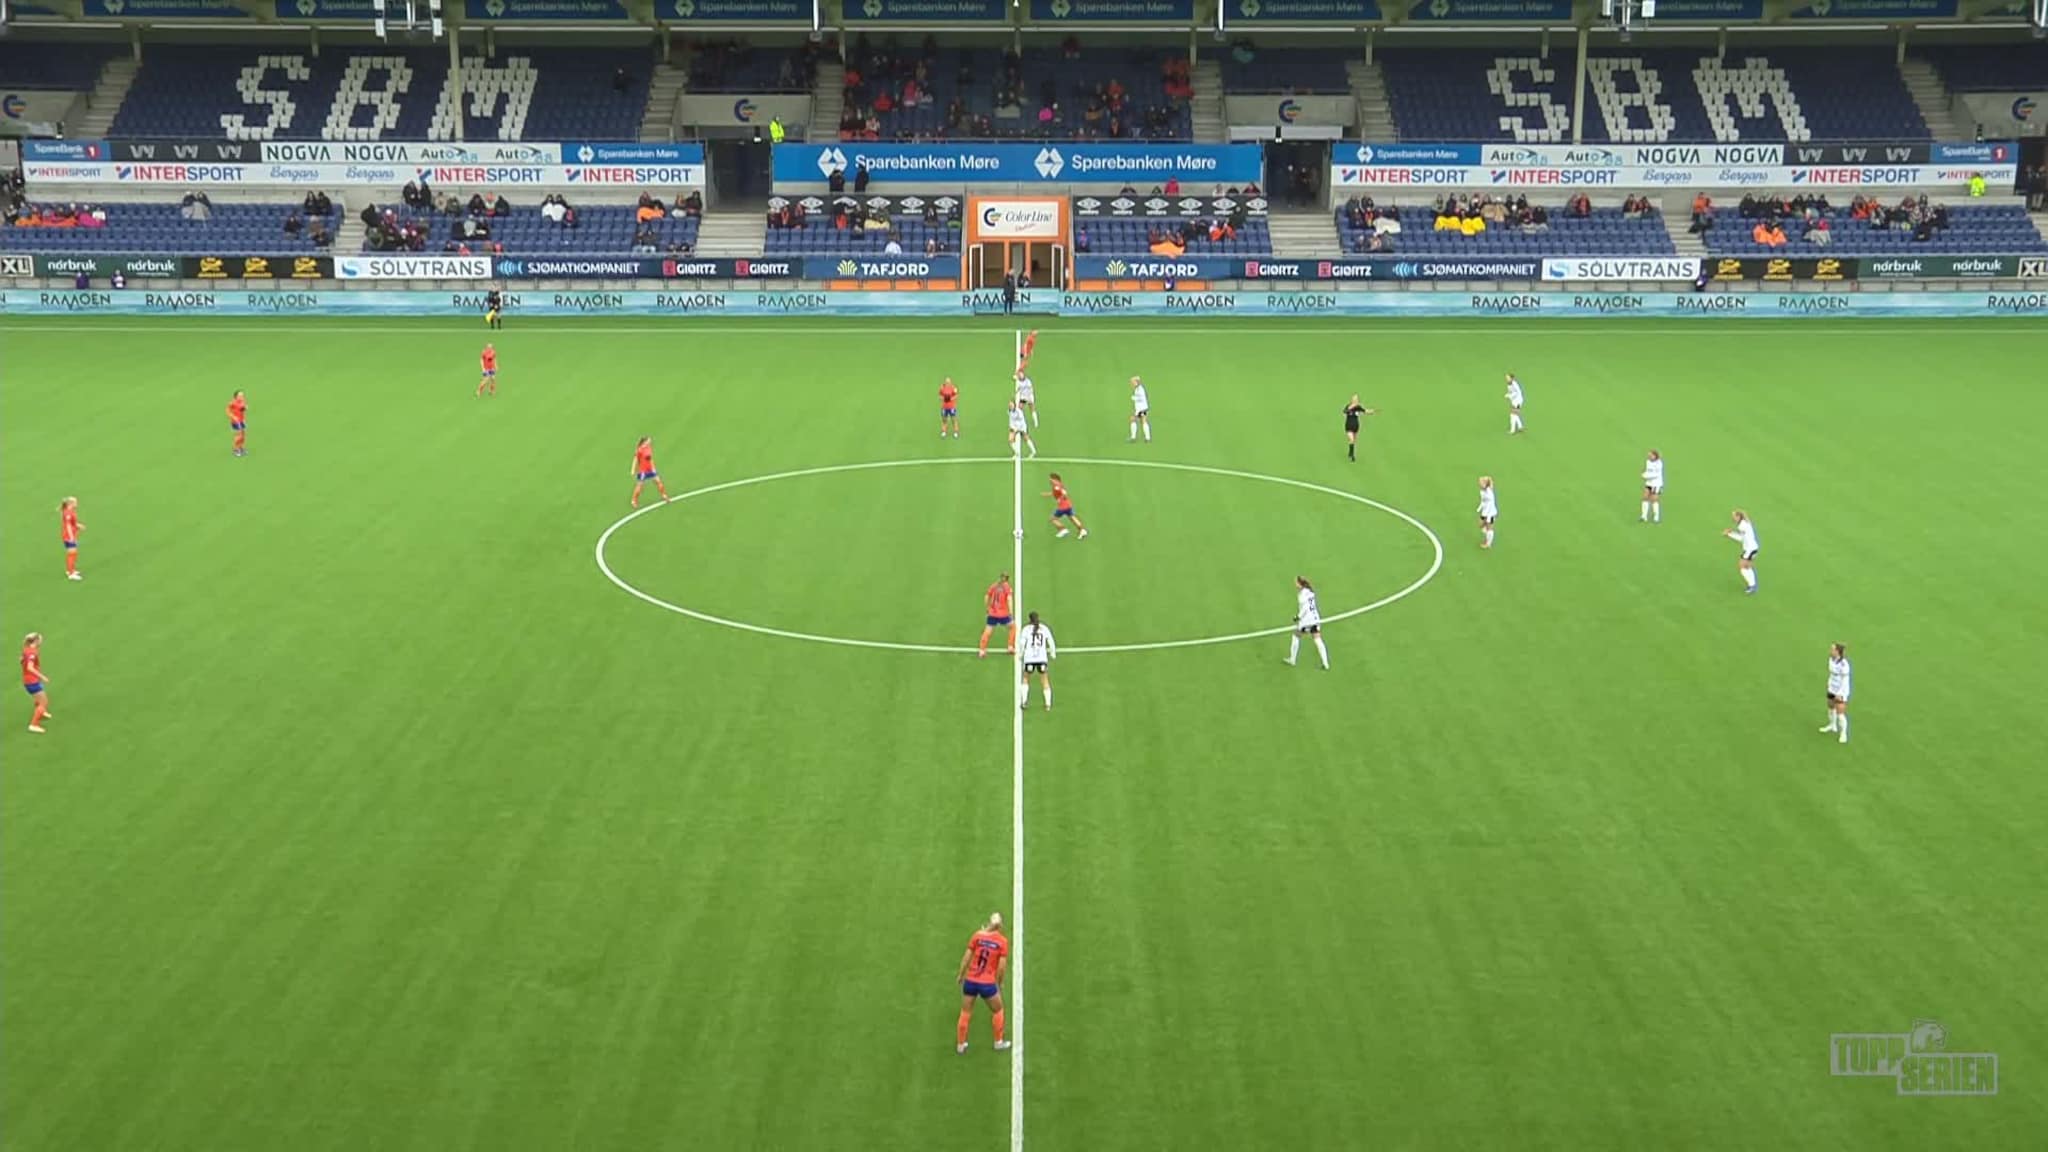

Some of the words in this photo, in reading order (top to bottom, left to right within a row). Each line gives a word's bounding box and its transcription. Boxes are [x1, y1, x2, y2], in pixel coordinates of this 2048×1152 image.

[267, 146, 330, 161] NOGVA
[345, 146, 408, 161] NOGVA
[1637, 148, 1700, 163] NOGVA
[1715, 148, 1779, 163] NOGVA
[855, 155, 956, 173] Sparebanken
[960, 155, 999, 169] Møre
[1072, 155, 1173, 173] Sparebanken
[1177, 155, 1216, 169] Møre
[38, 168, 101, 177] INTERSPORT
[134, 167, 244, 181] INTERSPORT
[434, 168, 543, 182] INTERSPORT
[583, 169, 692, 182] INTERSPORT
[1359, 170, 1468, 183] INTERSPORT
[1508, 170, 1617, 183] INTERSPORT
[1808, 169, 1920, 183] INTERSPORT
[1947, 169, 2010, 179] INTESPORT
[861, 263, 929, 275] TAFJORD
[1130, 263, 1198, 276] TAFJORD
[1031, 632, 1044, 647] 19
